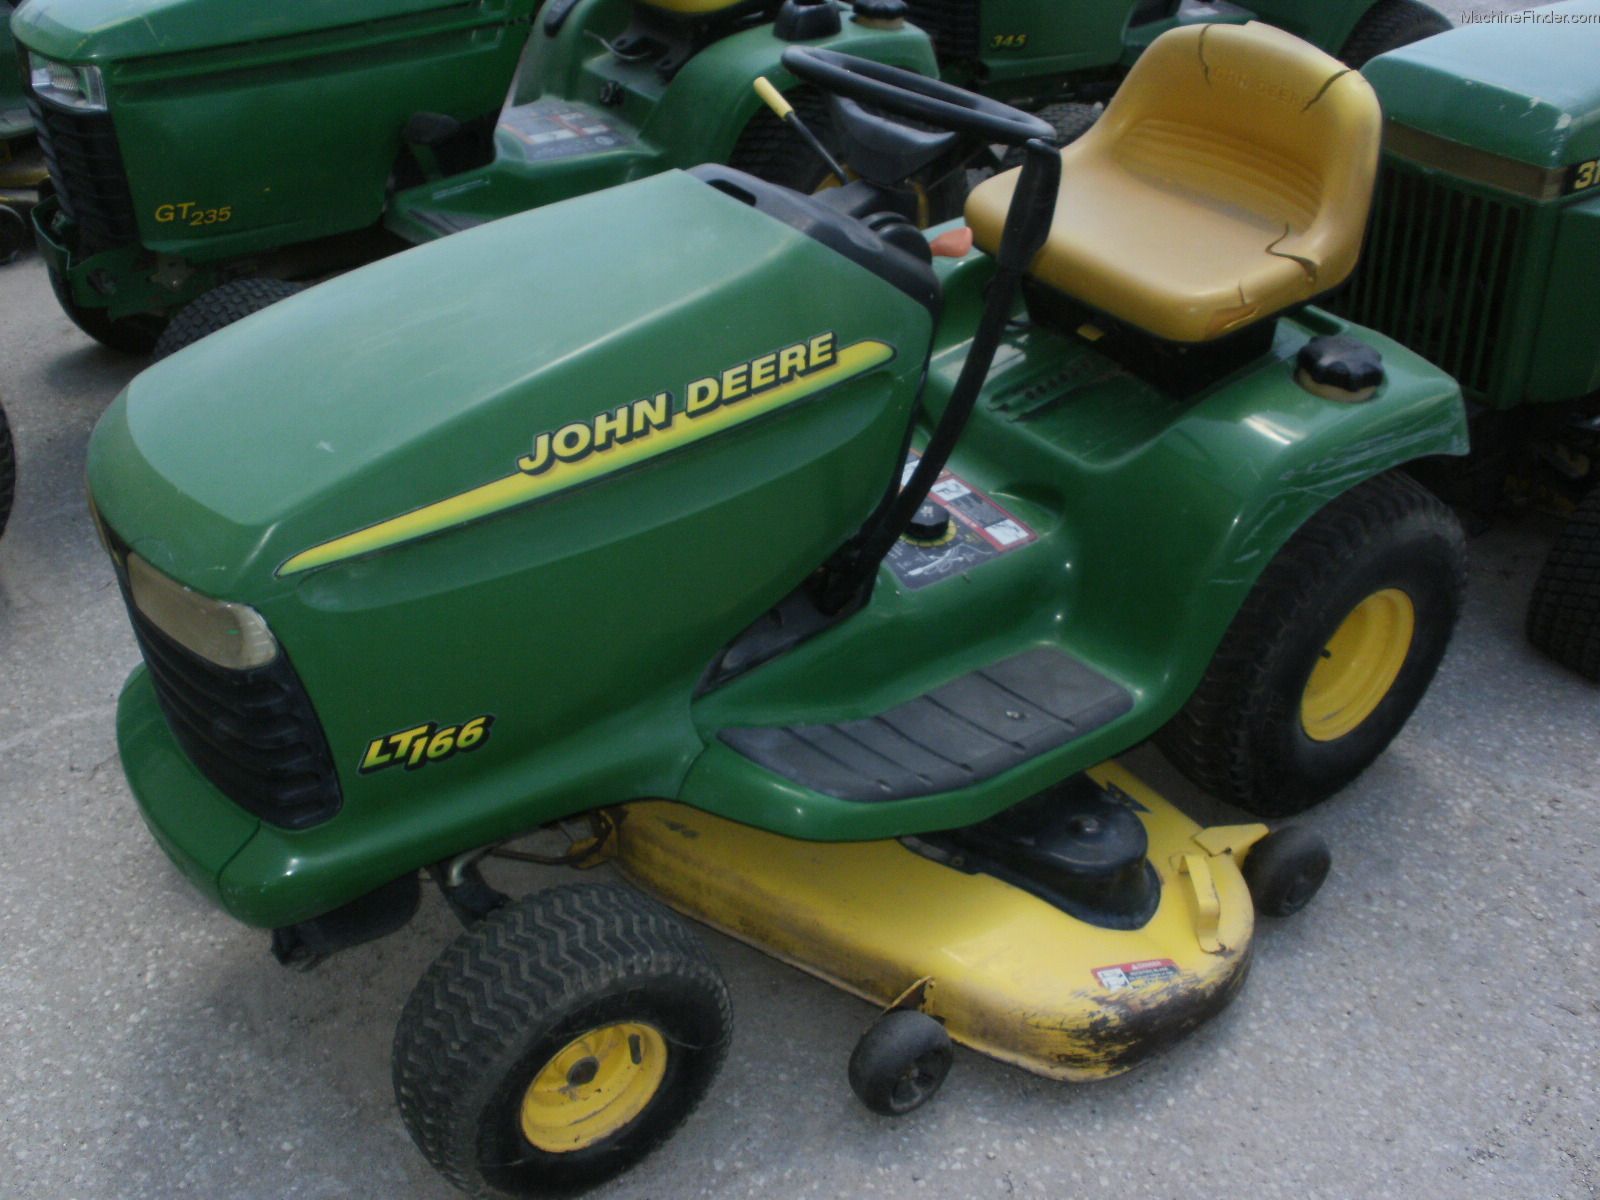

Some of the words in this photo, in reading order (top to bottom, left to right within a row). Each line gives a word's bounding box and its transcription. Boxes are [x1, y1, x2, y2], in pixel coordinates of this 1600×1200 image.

[990, 33, 1027, 49] 345
[154, 201, 232, 226] GT235
[516, 391, 671, 475] JOHN
[685, 331, 837, 418] DEERE
[358, 715, 494, 773] LT166
